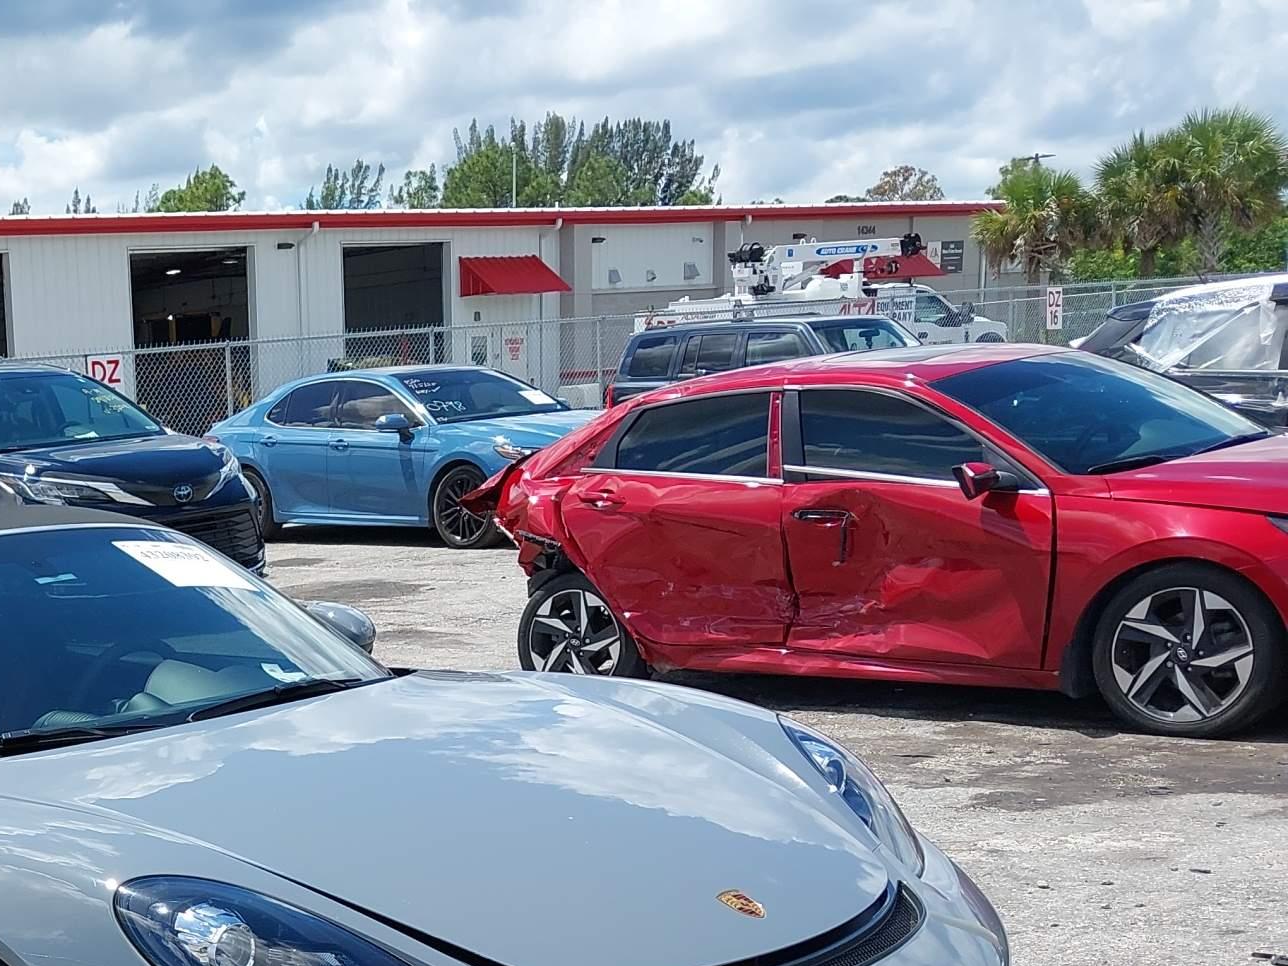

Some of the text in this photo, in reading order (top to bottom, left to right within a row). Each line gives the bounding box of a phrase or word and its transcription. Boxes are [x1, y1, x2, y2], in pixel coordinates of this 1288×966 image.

[876, 300, 914, 313] EQUPMENT
[1048, 290, 1062, 308] DZ
[1049, 309, 1059, 326] 16
[91, 359, 121, 384] DZ
